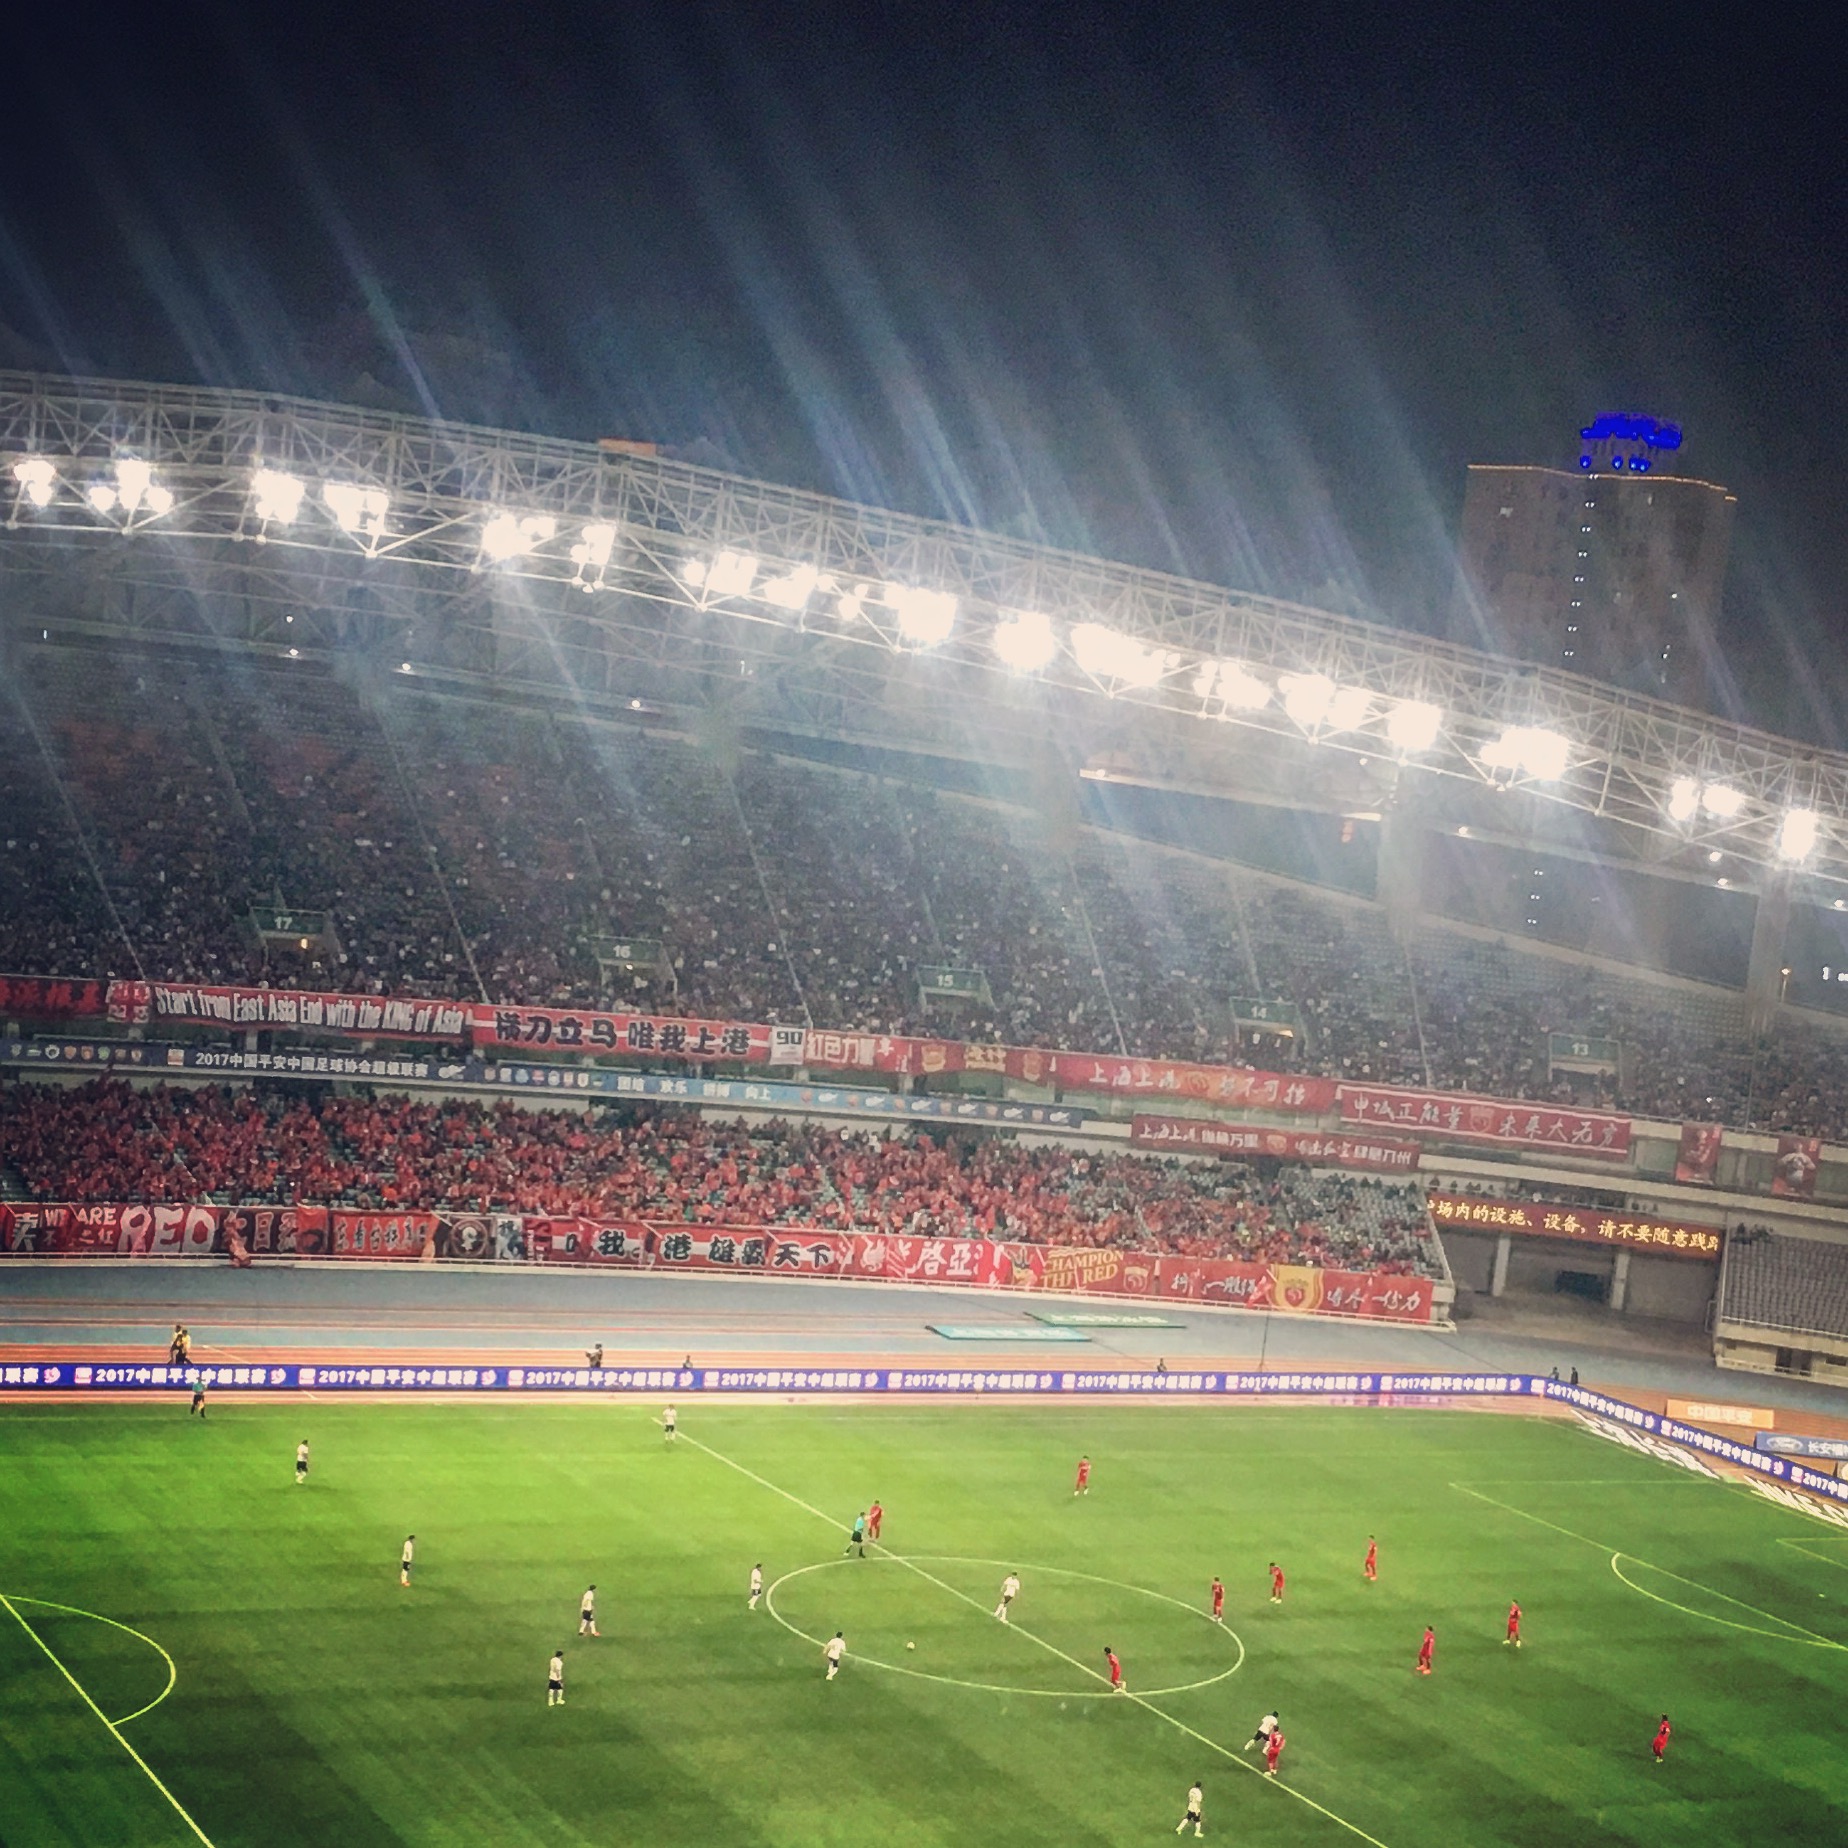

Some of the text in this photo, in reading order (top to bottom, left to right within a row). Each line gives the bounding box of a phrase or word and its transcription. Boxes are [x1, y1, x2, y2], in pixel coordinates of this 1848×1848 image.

[275, 916, 292, 929] 17
[613, 945, 630, 958] 16
[937, 974, 953, 987] 15
[155, 986, 463, 1034] Start from East Asia End with the KING of Asia
[1251, 1006, 1267, 1019] 14
[628, 1021, 750, 1055] 唯我上港
[1572, 1043, 1588, 1055] 13
[77, 1206, 117, 1226] ARE
[118, 1205, 215, 1252] RED
[1044, 1251, 1124, 1273] CHAMPION
[1083, 1264, 1119, 1284] RED
